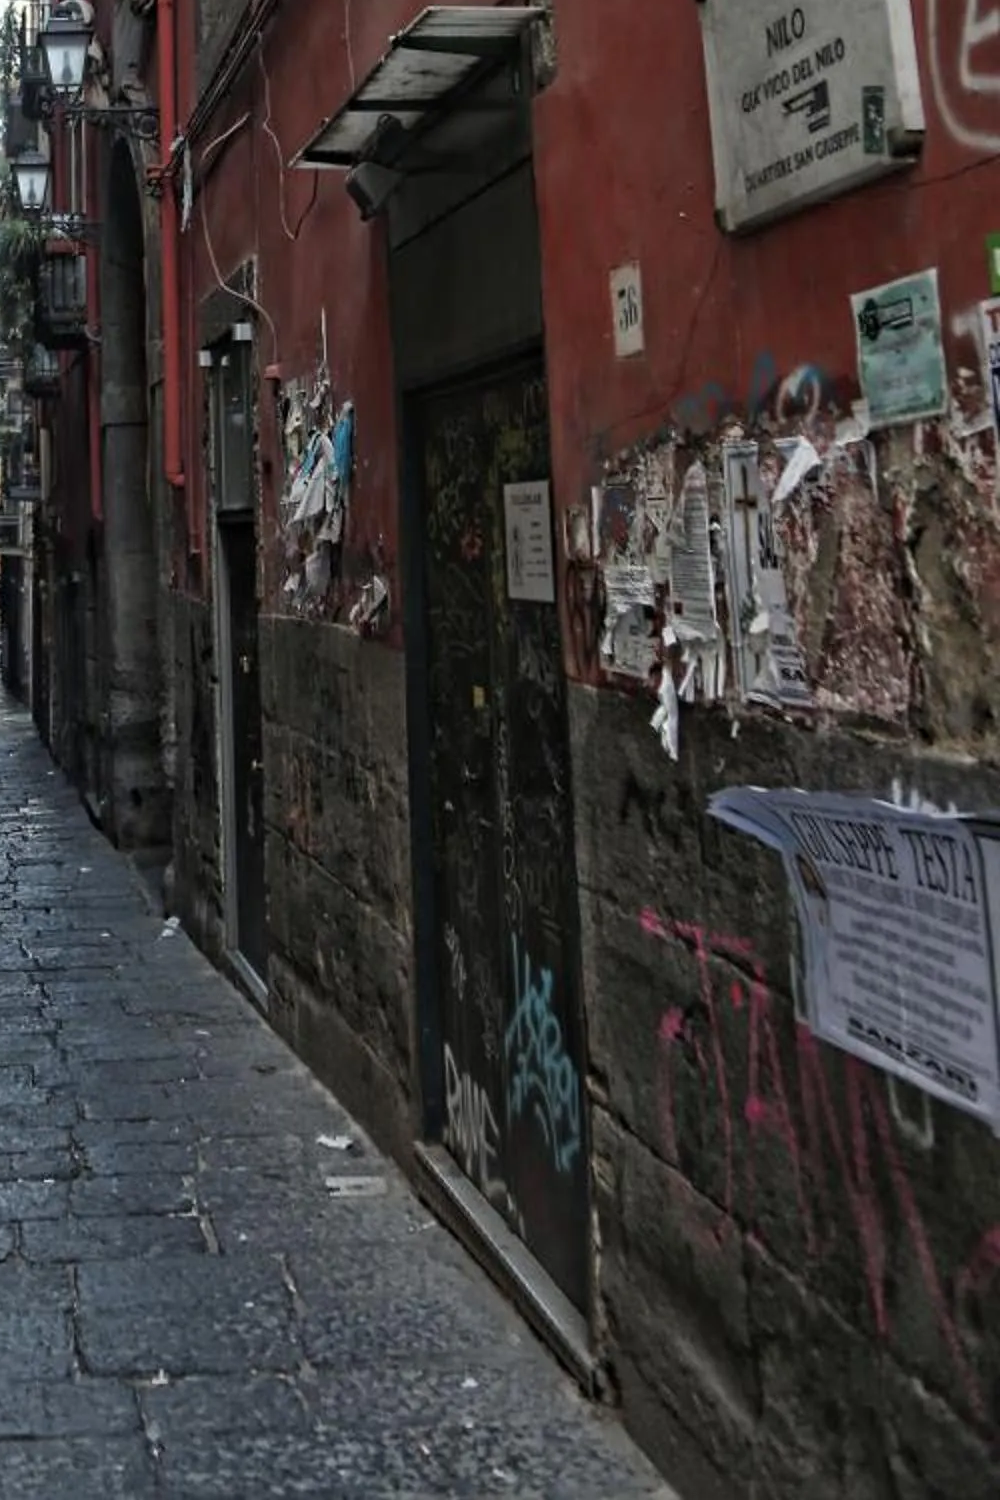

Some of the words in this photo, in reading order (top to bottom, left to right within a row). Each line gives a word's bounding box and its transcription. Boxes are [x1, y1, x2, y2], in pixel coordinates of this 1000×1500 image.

[765, 8, 806, 59] NILO
[763, 69, 791, 101] VICO
[792, 57, 815, 85] DEL
[815, 37, 846, 72] NILO
[745, 154, 793, 194] QUARTIERE
[793, 144, 815, 171] SAN
[815, 122, 861, 161] GIUSEPPE
[790, 810, 900, 882] GIUSEPPE
[898, 829, 978, 905] TESTA
